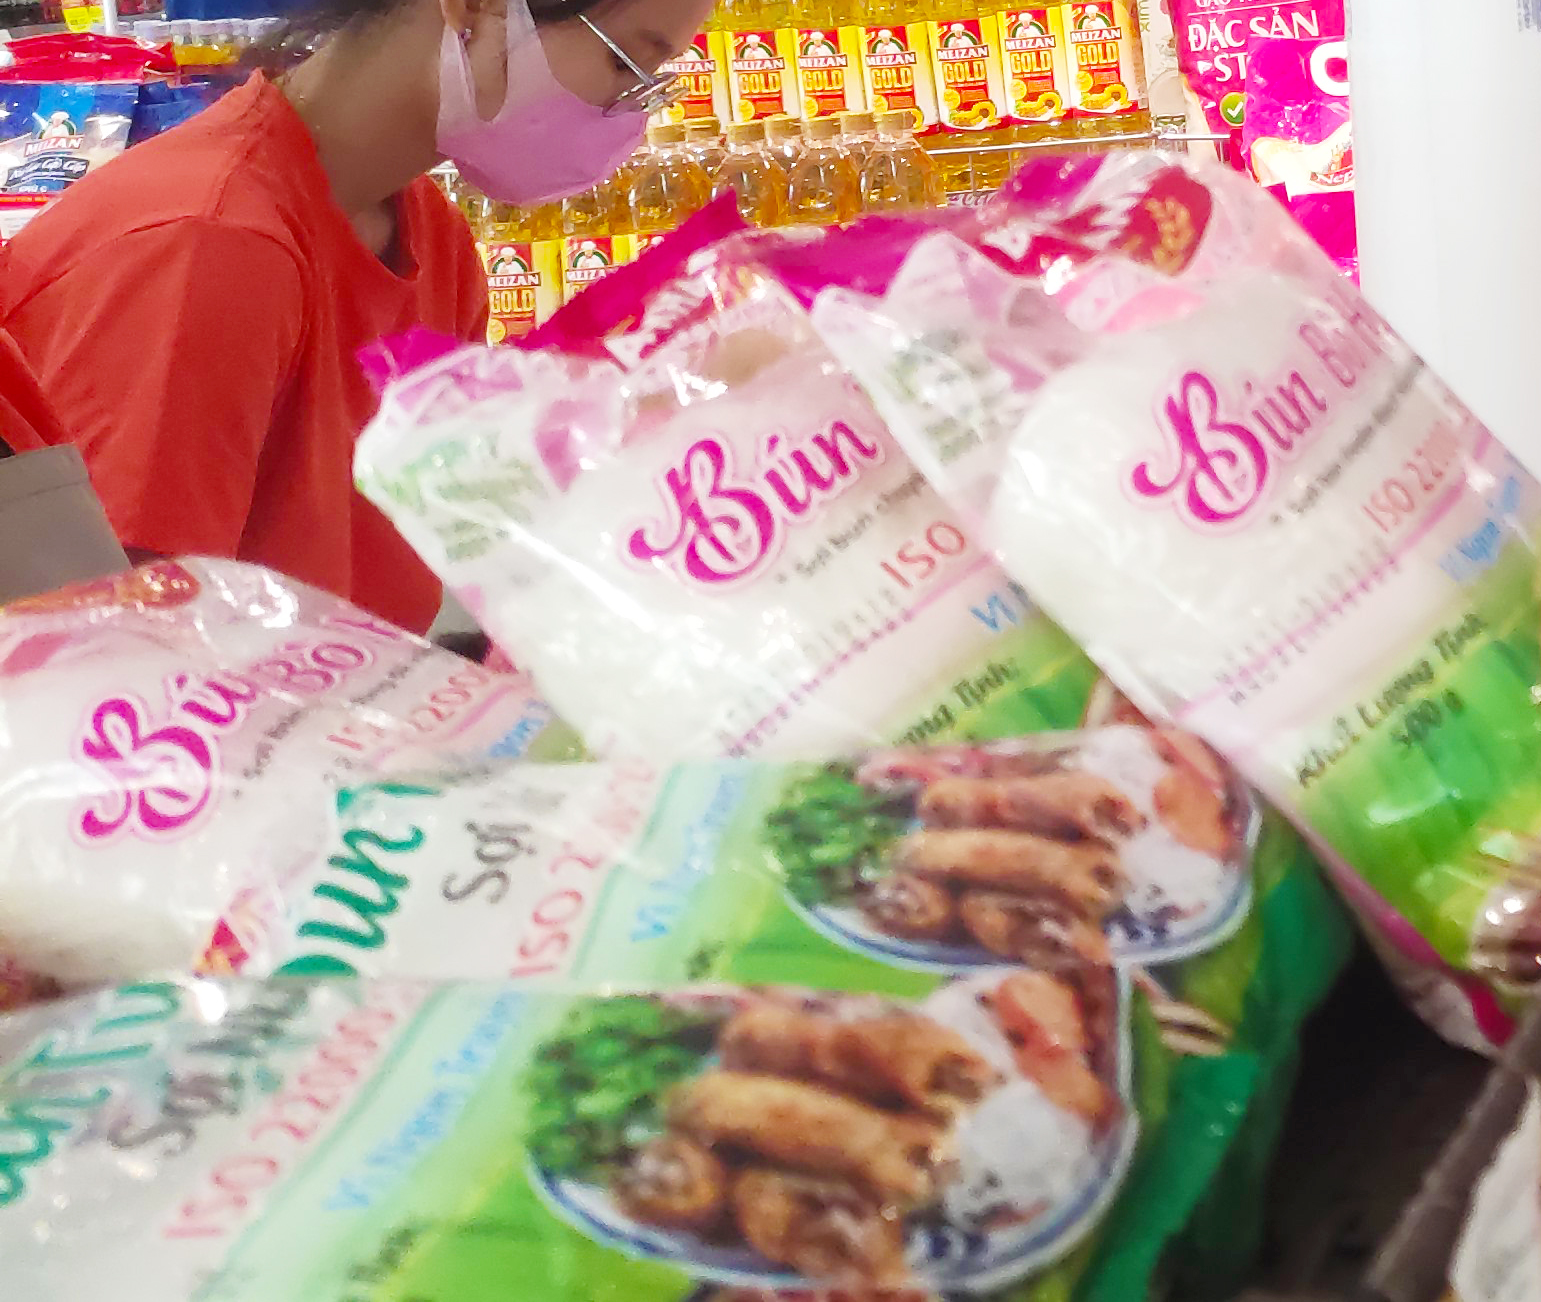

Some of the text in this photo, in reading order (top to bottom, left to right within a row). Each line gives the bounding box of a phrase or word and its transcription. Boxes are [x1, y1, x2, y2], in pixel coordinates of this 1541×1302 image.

[1187, 6, 1320, 53] ĐẶC SẢN
[1011, 51, 1052, 74] GOLD
[1077, 42, 1119, 66] GOLD
[738, 72, 781, 94] GOLD
[803, 69, 844, 90] GOLD
[872, 67, 913, 89] GOLD
[943, 61, 985, 83] GOLD
[489, 289, 536, 314] GOLD
[1131, 366, 1329, 525] Bún
[628, 417, 882, 585] Bún
[1361, 477, 1416, 533] ISO
[879, 518, 969, 591] ISO
[510, 886, 586, 980] ISO
